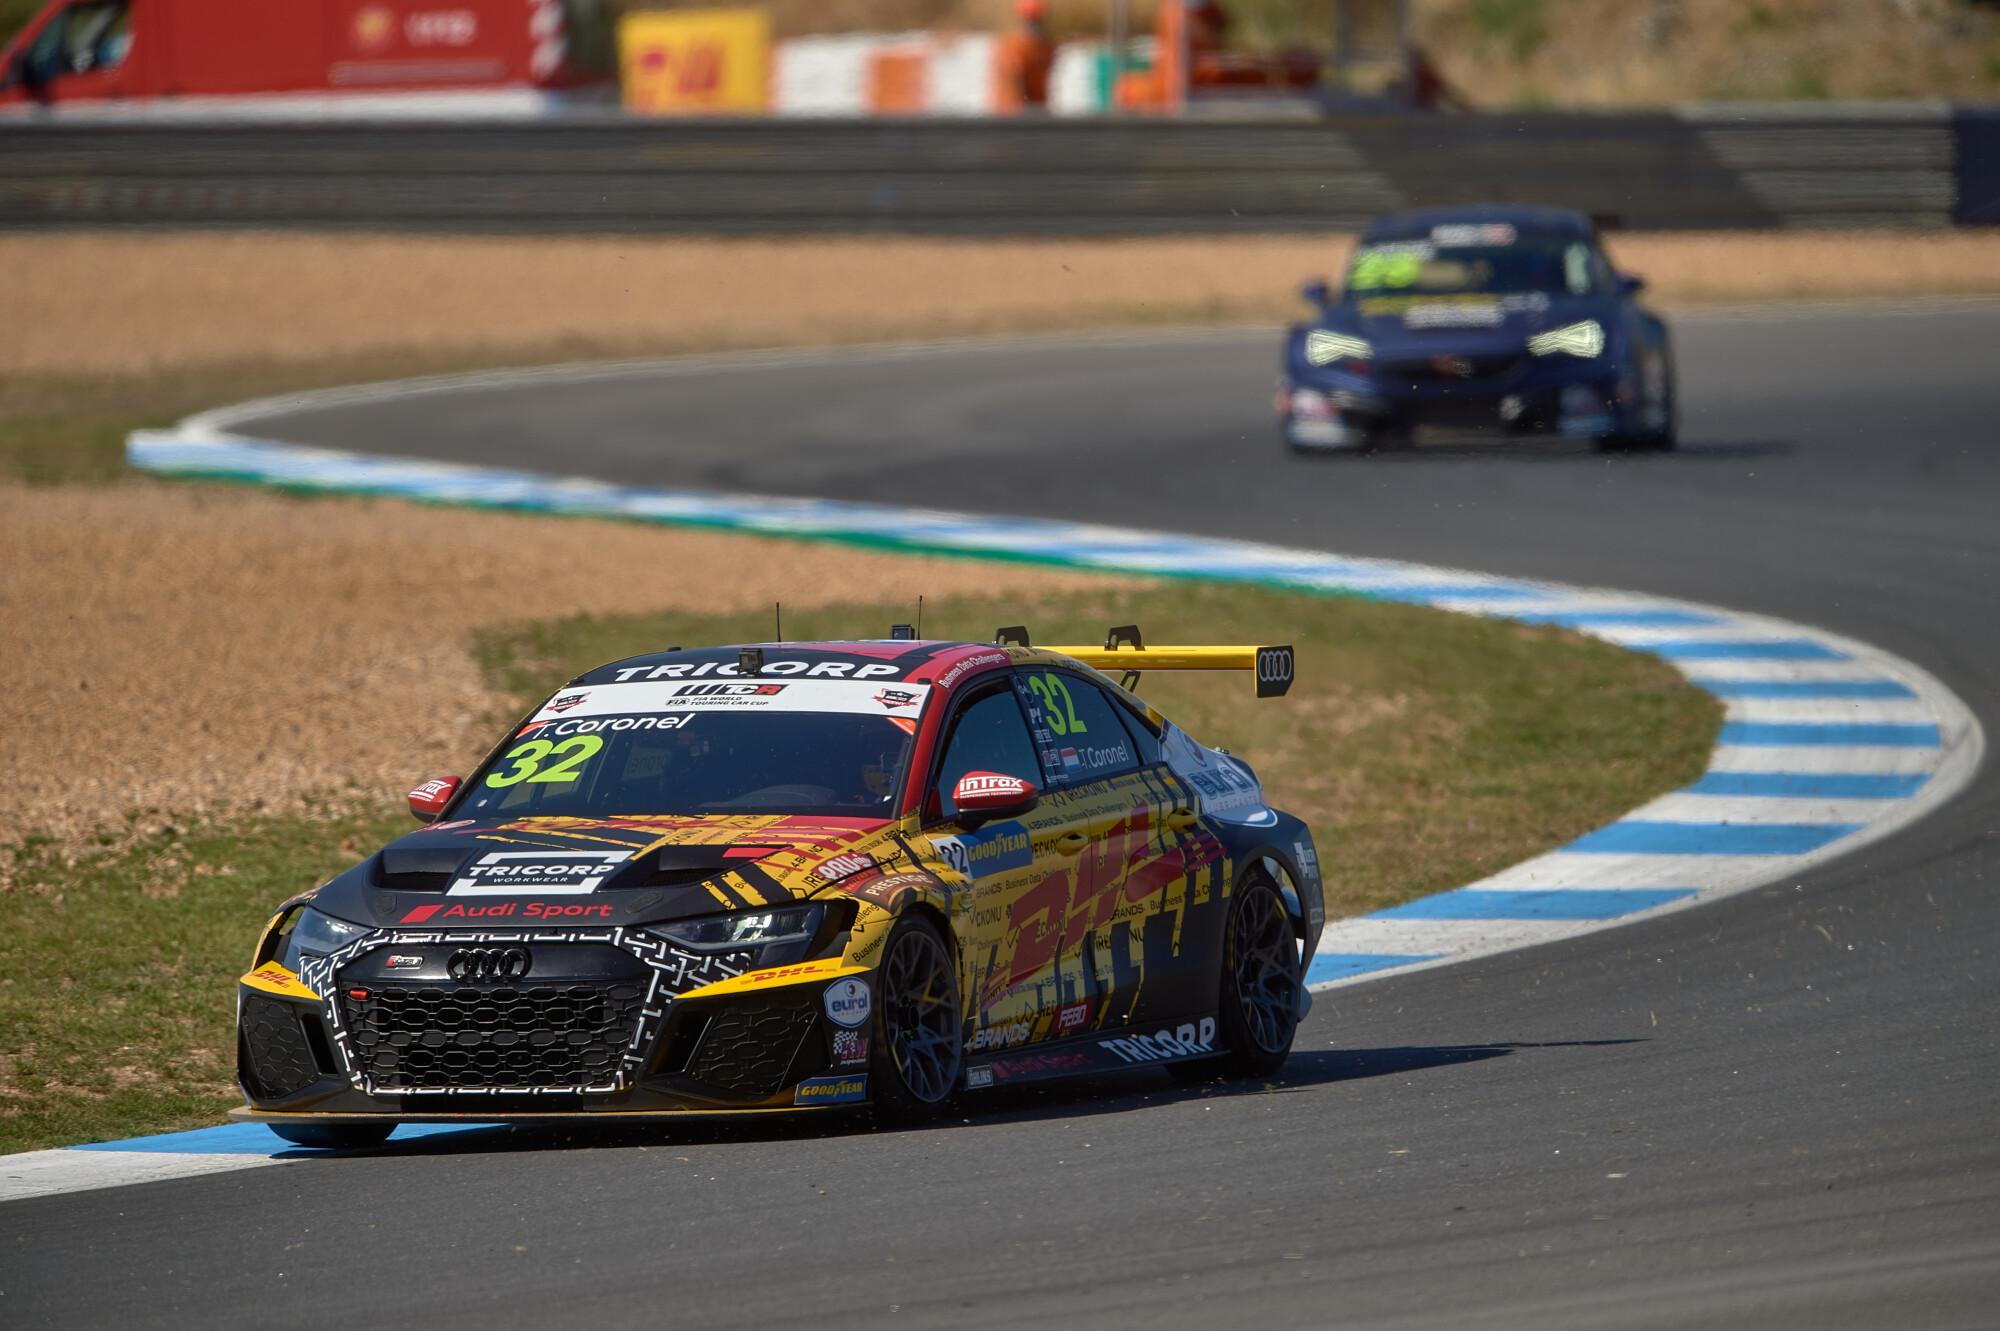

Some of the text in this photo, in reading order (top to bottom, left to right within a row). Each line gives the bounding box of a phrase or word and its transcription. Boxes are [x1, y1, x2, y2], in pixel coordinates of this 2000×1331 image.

[615, 661, 900, 682] TRICORP
[938, 653, 1006, 689] Business Data Challengers
[1028, 673, 1088, 736] 32
[486, 735, 604, 788] 32
[959, 778, 1024, 792] inTrax
[968, 832, 1028, 861] GOODYEAR
[941, 842, 969, 875] 32
[469, 863, 615, 878] TRICORP
[864, 874, 934, 896] PRESTIGE
[1005, 878, 1029, 890] Business
[1029, 873, 1042, 884] Data
[441, 902, 613, 920] Audi Sport
[751, 965, 824, 982] DHL
[831, 993, 869, 1013] eurol
[1059, 1004, 1088, 1030] FEBO
[1097, 1016, 1216, 1063] TRICORP
[801, 1080, 863, 1098] GOODYEAR
